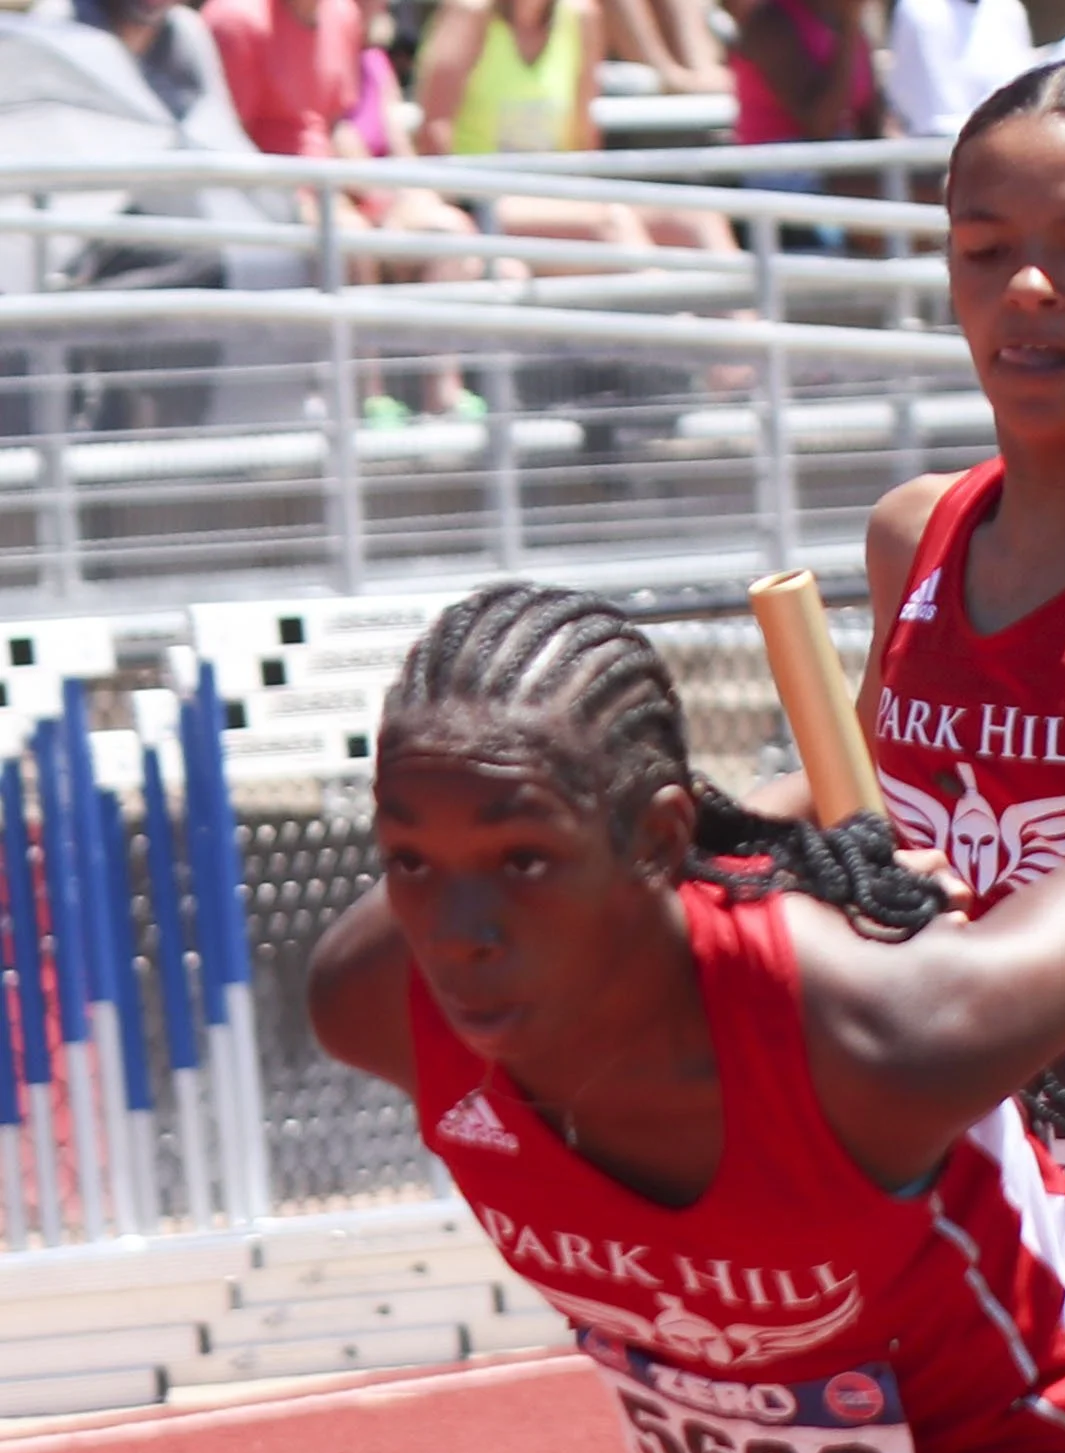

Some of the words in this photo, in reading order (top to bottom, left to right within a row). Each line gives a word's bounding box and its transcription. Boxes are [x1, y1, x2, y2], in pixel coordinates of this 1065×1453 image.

[876, 685, 966, 752] PARK
[477, 1203, 663, 1288] PARK
[672, 1253, 858, 1311] HILL
[648, 1361, 797, 1424] ZERO
